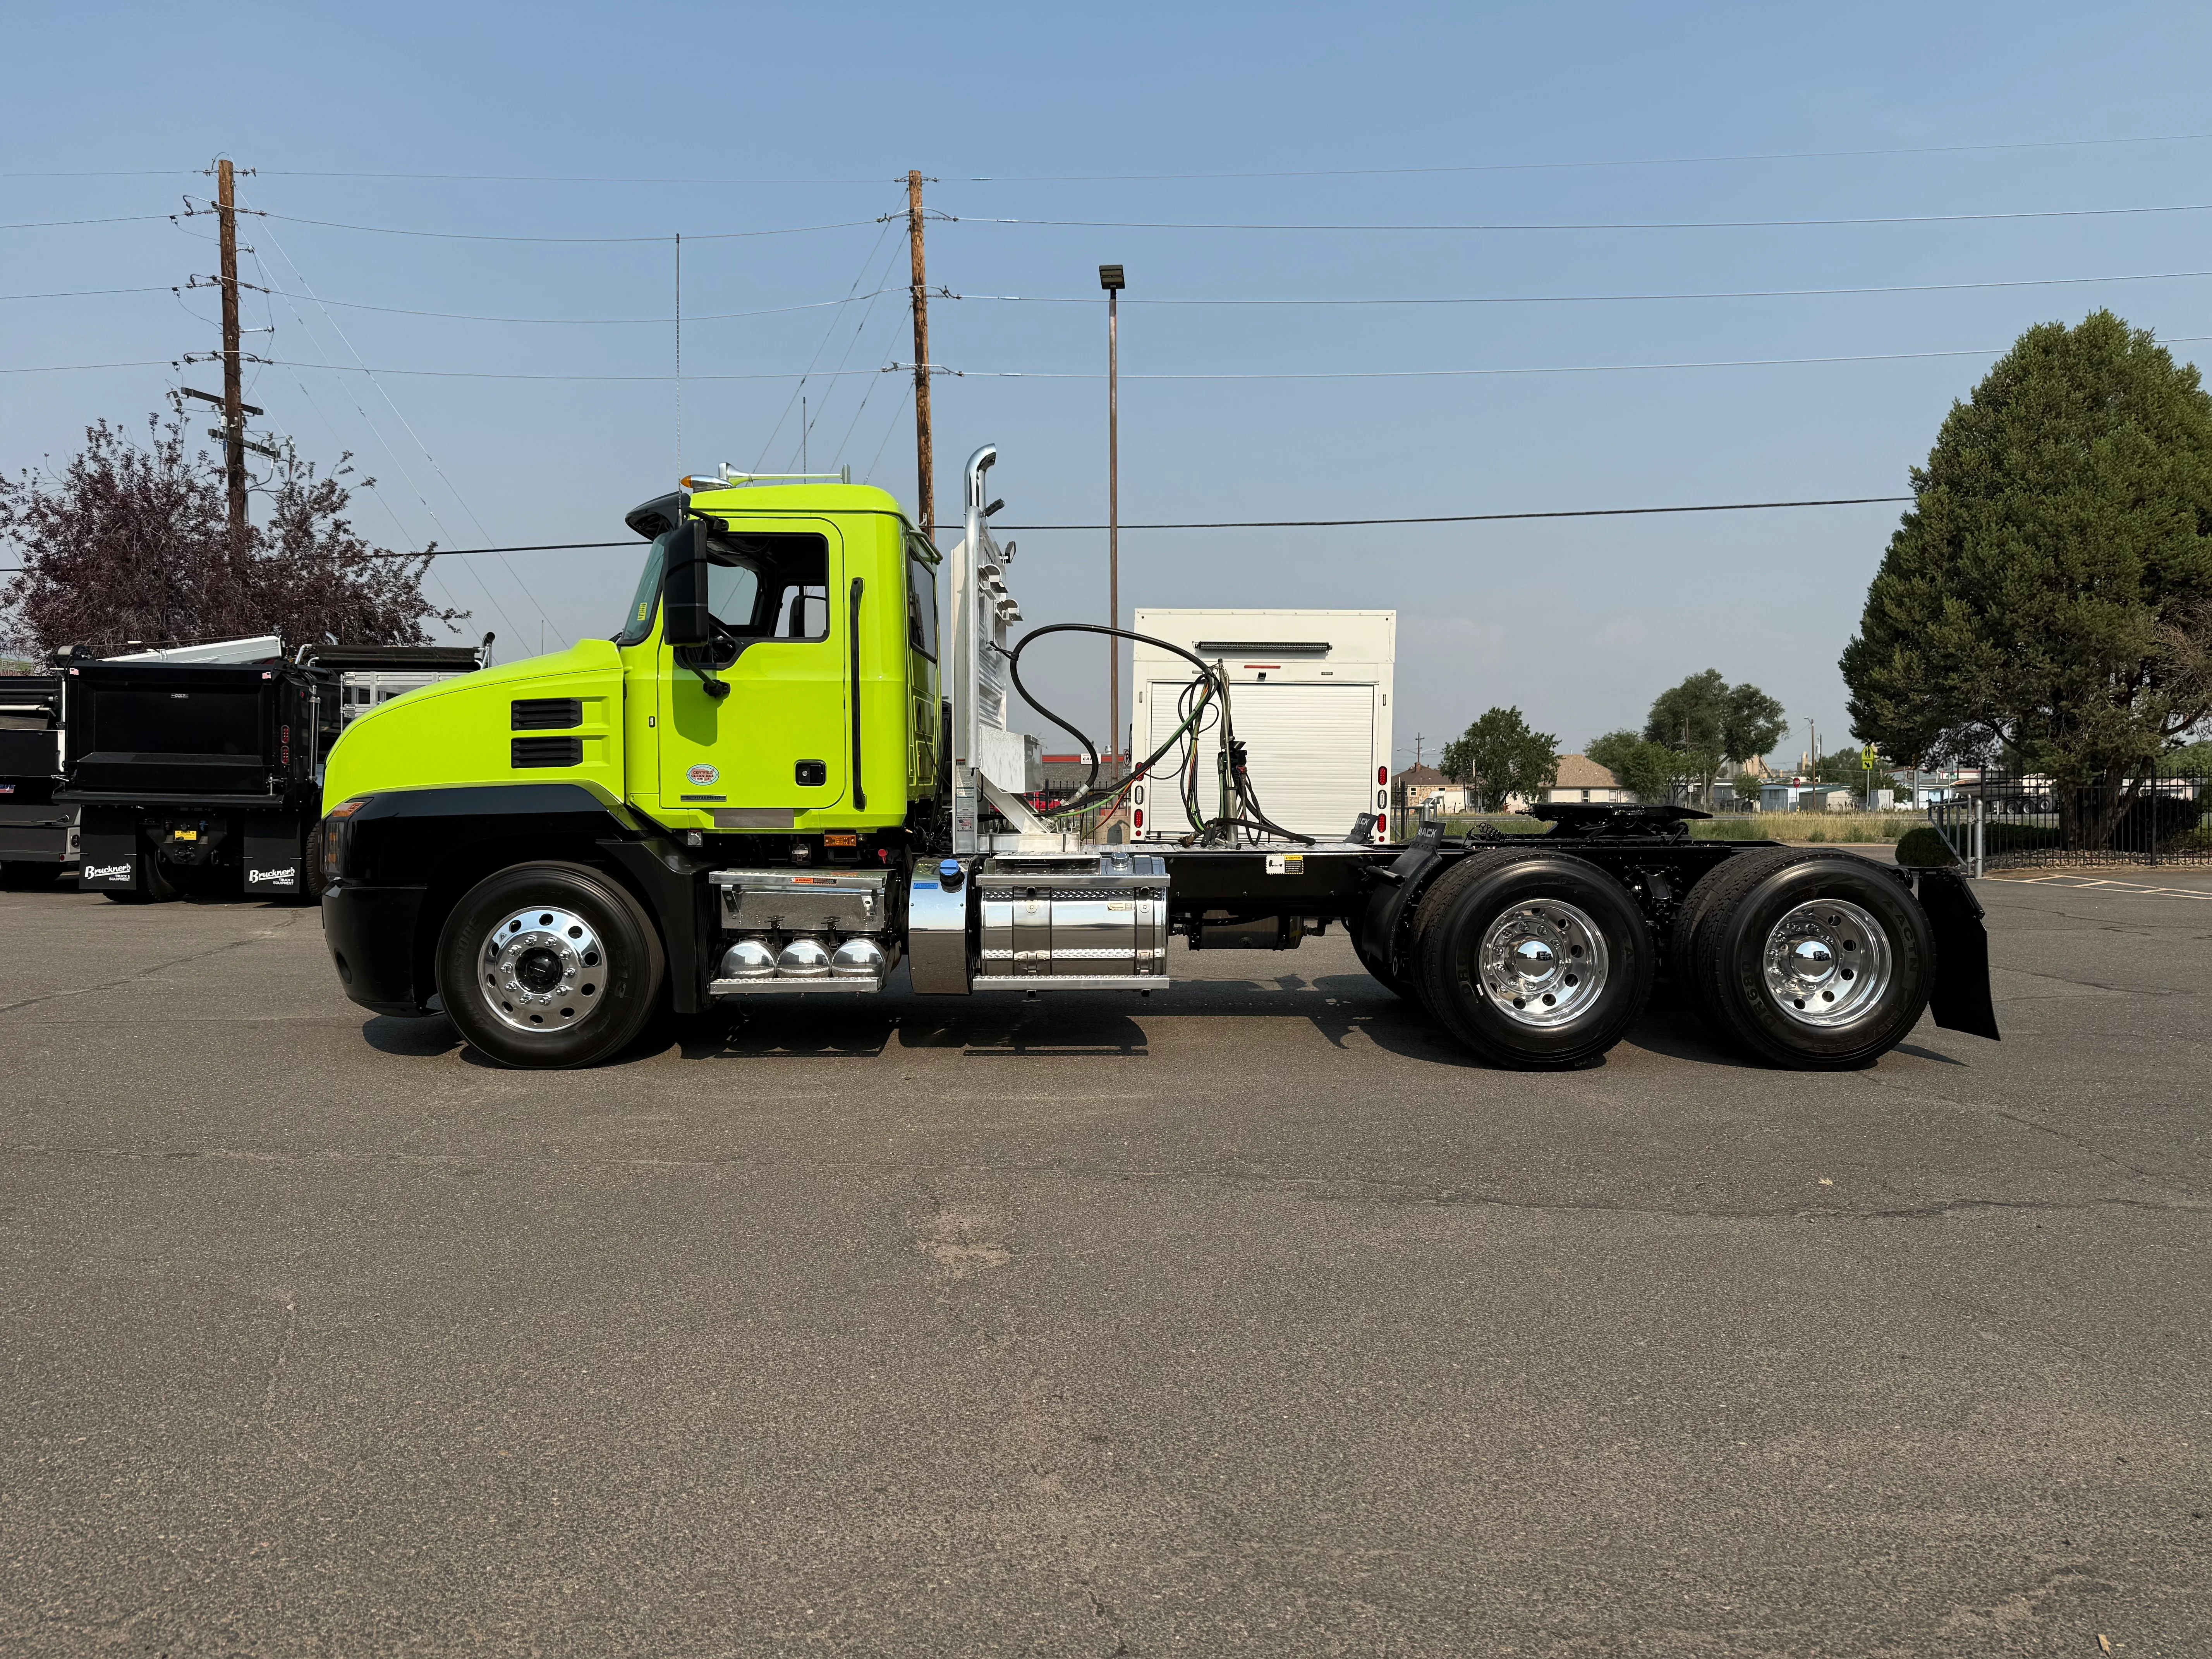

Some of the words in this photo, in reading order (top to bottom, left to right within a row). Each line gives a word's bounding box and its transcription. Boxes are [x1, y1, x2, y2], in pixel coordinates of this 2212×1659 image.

[1417, 827, 1437, 838] MACK
[84, 863, 131, 879] Bruckner's
[249, 867, 295, 883] Bruckner's
[1741, 960, 1778, 1028] DR680
